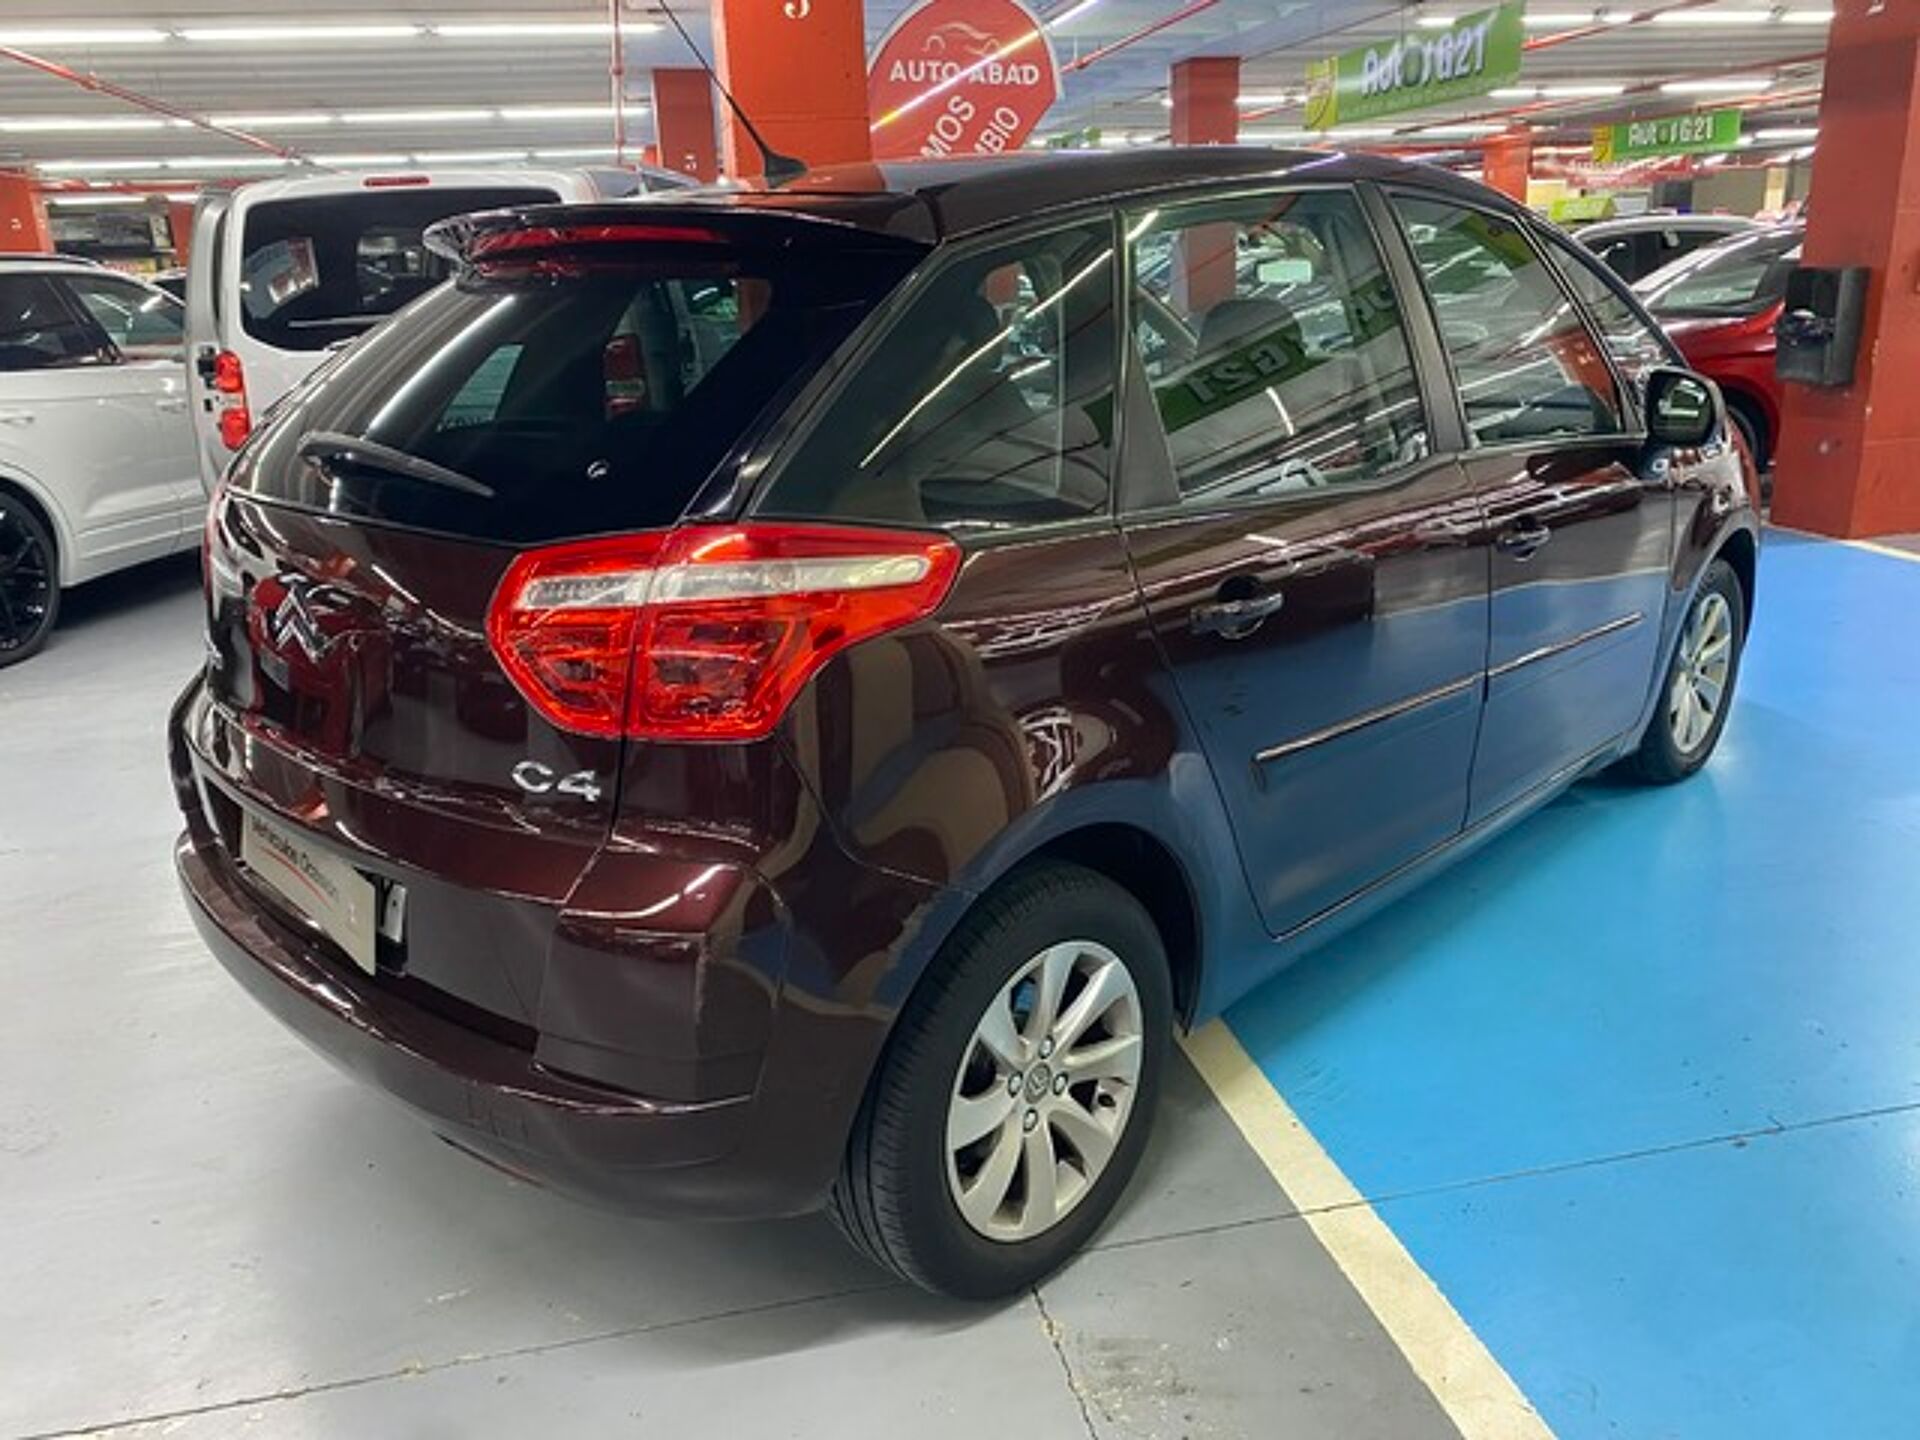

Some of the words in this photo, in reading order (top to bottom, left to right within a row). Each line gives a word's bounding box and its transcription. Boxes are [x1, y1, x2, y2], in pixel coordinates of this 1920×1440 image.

[890, 60, 961, 82] AUTO
[968, 63, 1040, 85] ABAD
[511, 761, 602, 802] C4
